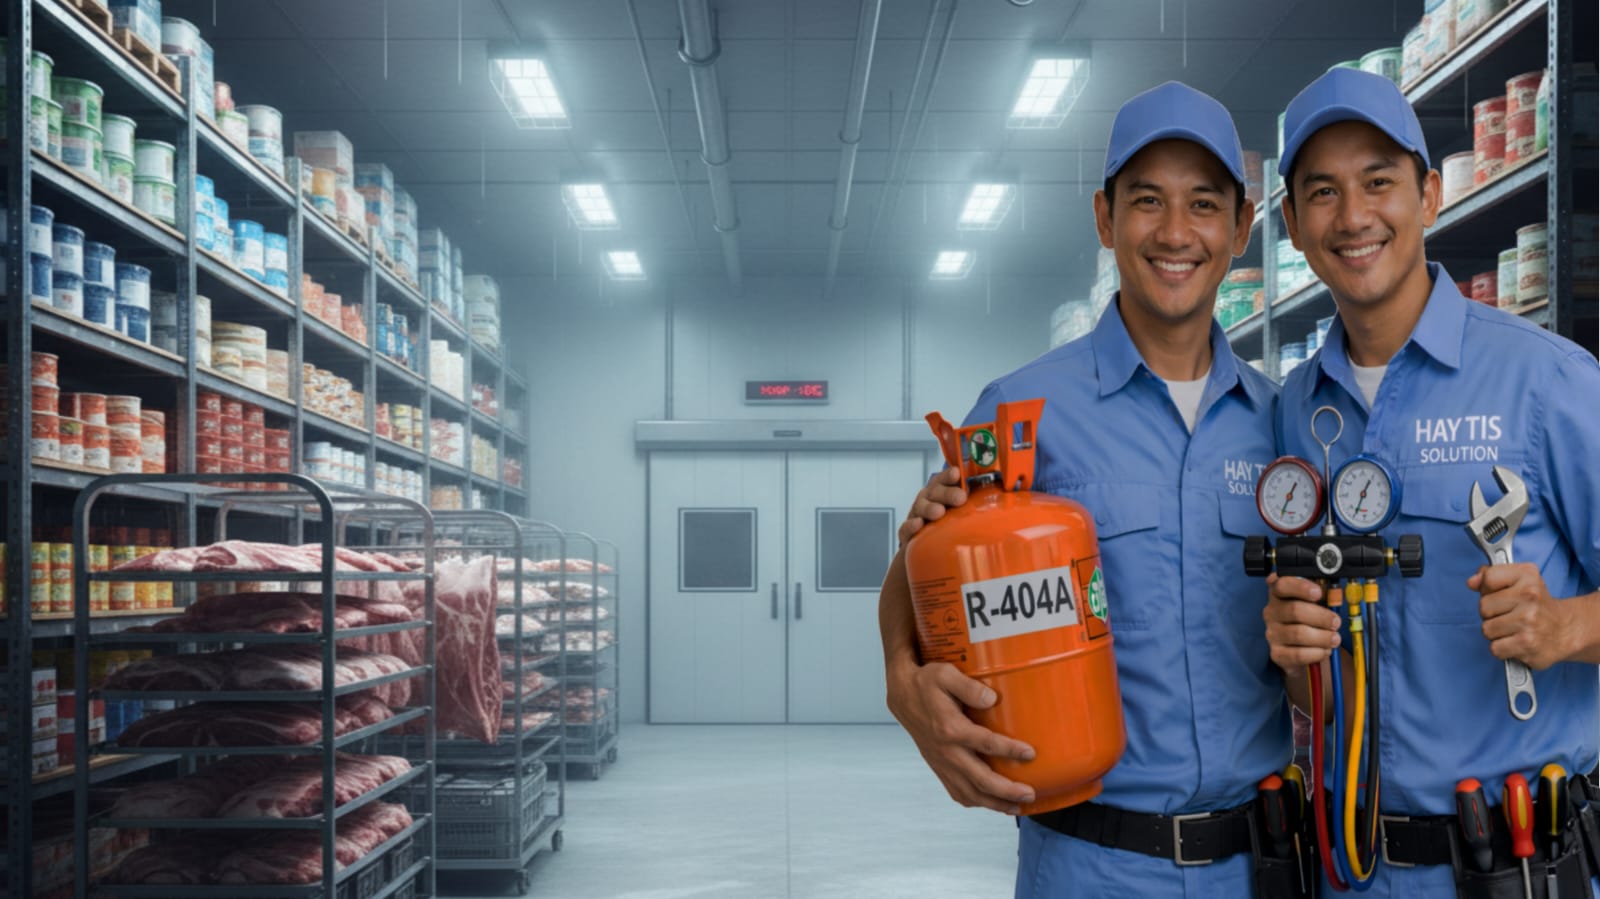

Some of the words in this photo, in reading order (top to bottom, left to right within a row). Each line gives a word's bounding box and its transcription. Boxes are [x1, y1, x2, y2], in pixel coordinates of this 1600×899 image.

[1416, 418, 1463, 444] HAY
[1465, 415, 1502, 441] TIS
[1420, 446, 1498, 463] SOLUTION
[1224, 459, 1252, 481] HAY
[966, 576, 1074, 628] R-404A
